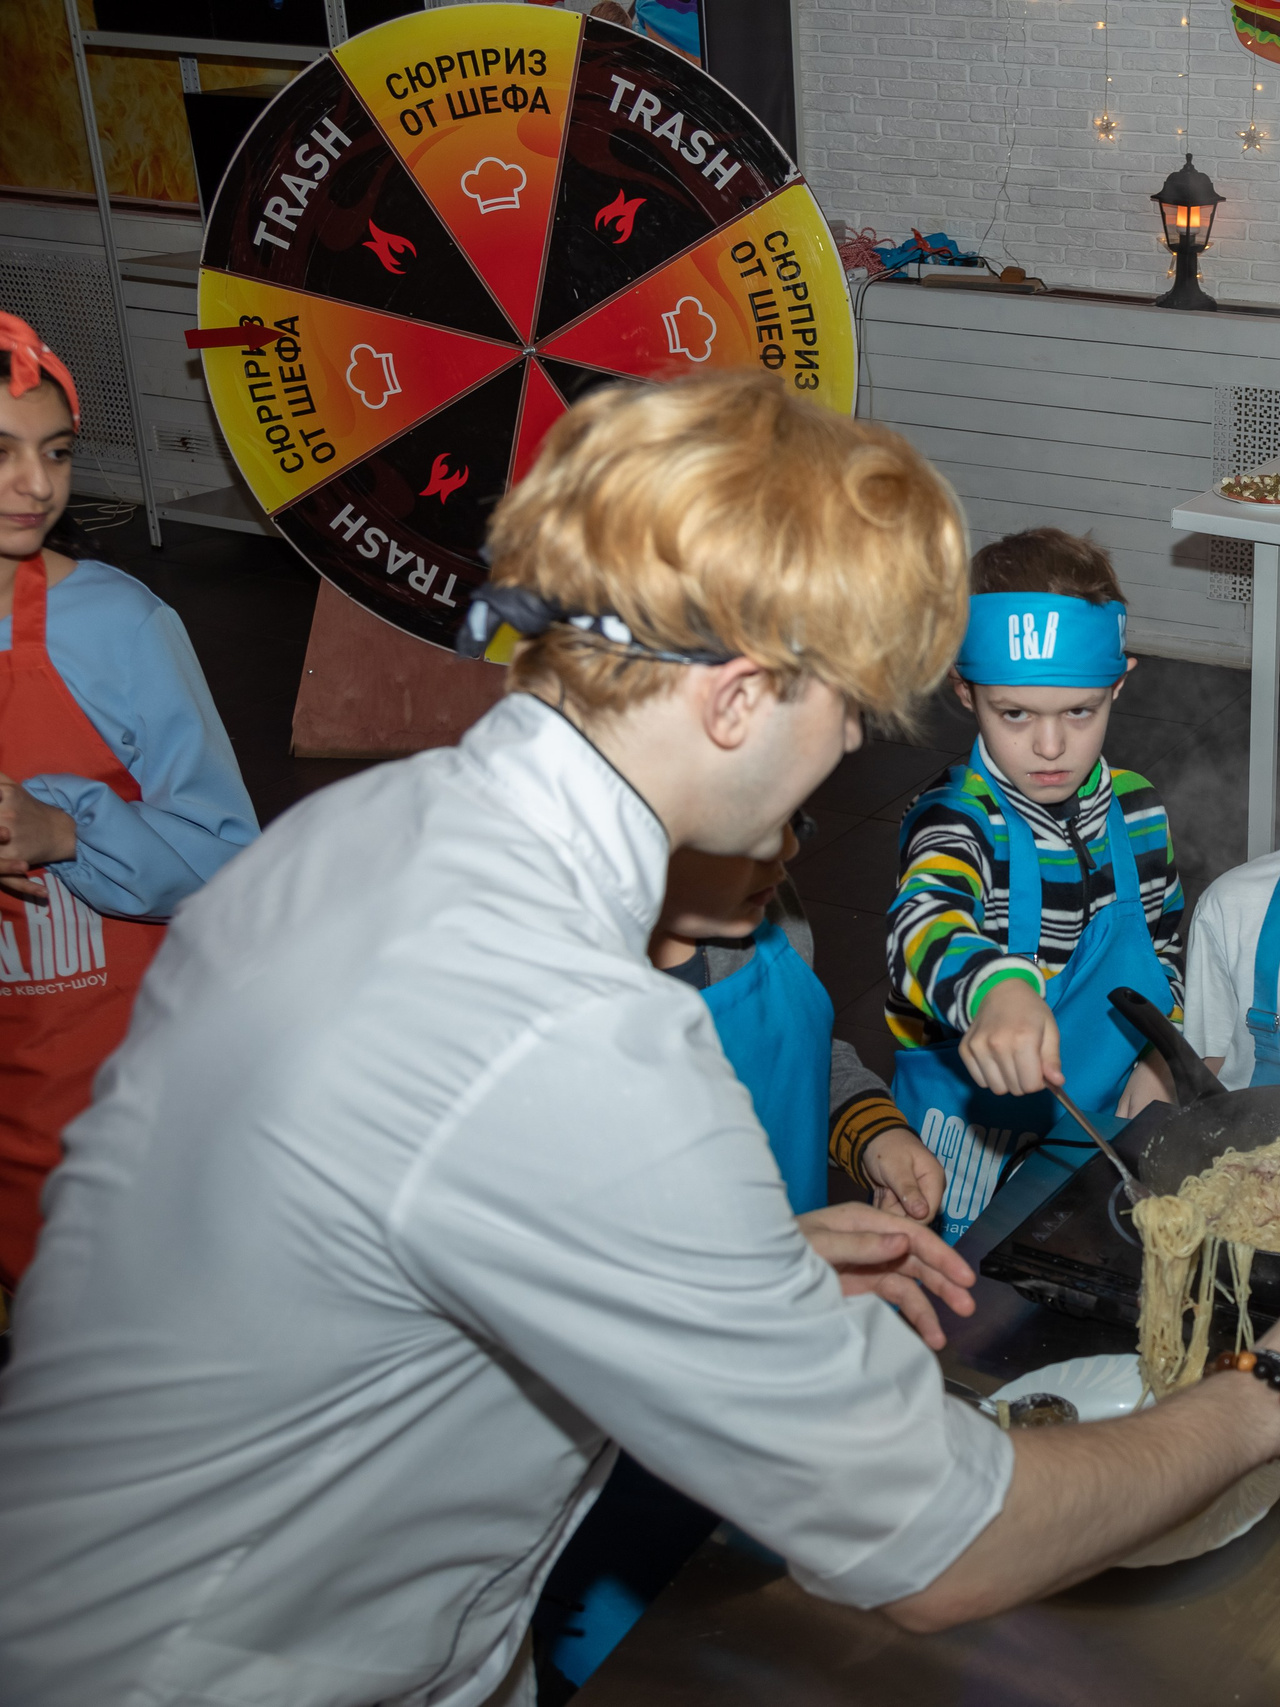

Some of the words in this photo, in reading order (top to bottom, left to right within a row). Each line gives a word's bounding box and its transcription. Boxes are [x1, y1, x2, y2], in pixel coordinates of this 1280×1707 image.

[385, 47, 547, 100] СЮРПРИЗ
[399, 99, 440, 136] ОТ
[448, 84, 551, 122] ШЕФА
[607, 75, 742, 191] TRASH
[253, 116, 352, 250] TRASH
[731, 241, 767, 278] ОТ
[748, 289, 786, 371] ШЕФ
[764, 230, 819, 390] СЮРПРИЗ
[274, 315, 316, 417] ШЕФА
[299, 428, 336, 464] ОТ
[329, 503, 458, 608] TRASH
[1008, 611, 1060, 661] C&R
[15, 972, 107, 996] квест-шоу
